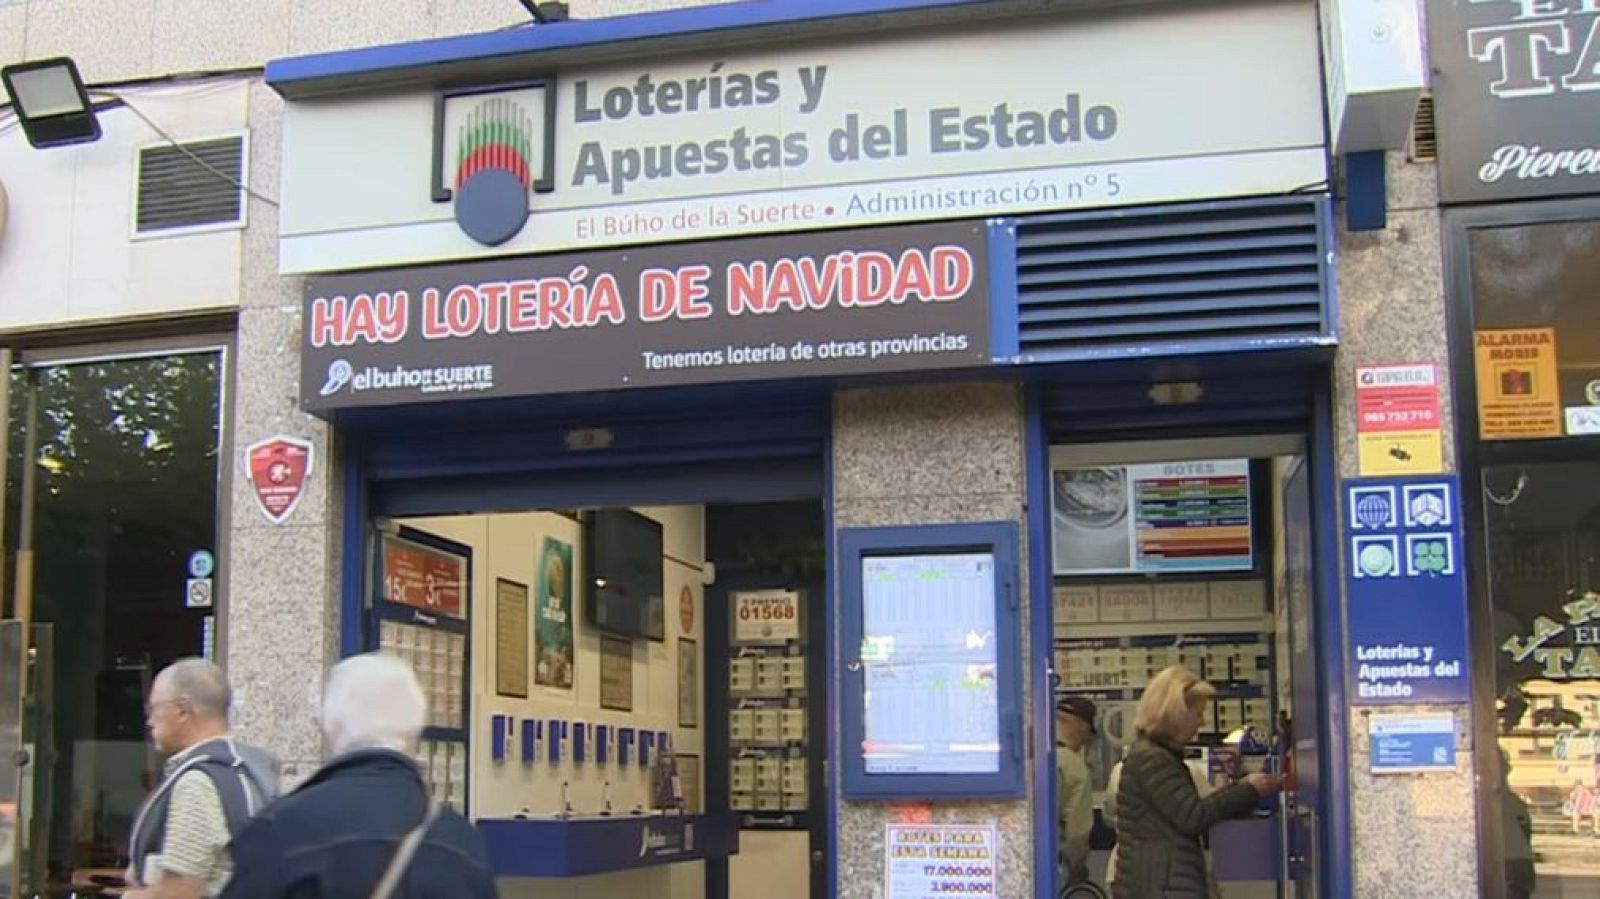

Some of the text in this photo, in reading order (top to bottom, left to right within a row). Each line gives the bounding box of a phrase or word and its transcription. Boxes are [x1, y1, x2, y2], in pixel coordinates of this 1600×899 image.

[574, 64, 827, 123] Loterías y
[571, 93, 1118, 194] Apuestas del Estado
[576, 173, 1121, 239] El Búho de la Suerte Administración nº 5
[639, 265, 712, 322] DE
[642, 331, 968, 369] Tenemos lotería de otras provincias
[1477, 332, 1551, 348] ALARMA
[434, 365, 494, 384] SUERTE
[740, 605, 794, 621] 01568
[1357, 643, 1433, 662] Loterías y
[1358, 660, 1460, 681] Apuestas del
[1358, 681, 1413, 698] Estado
